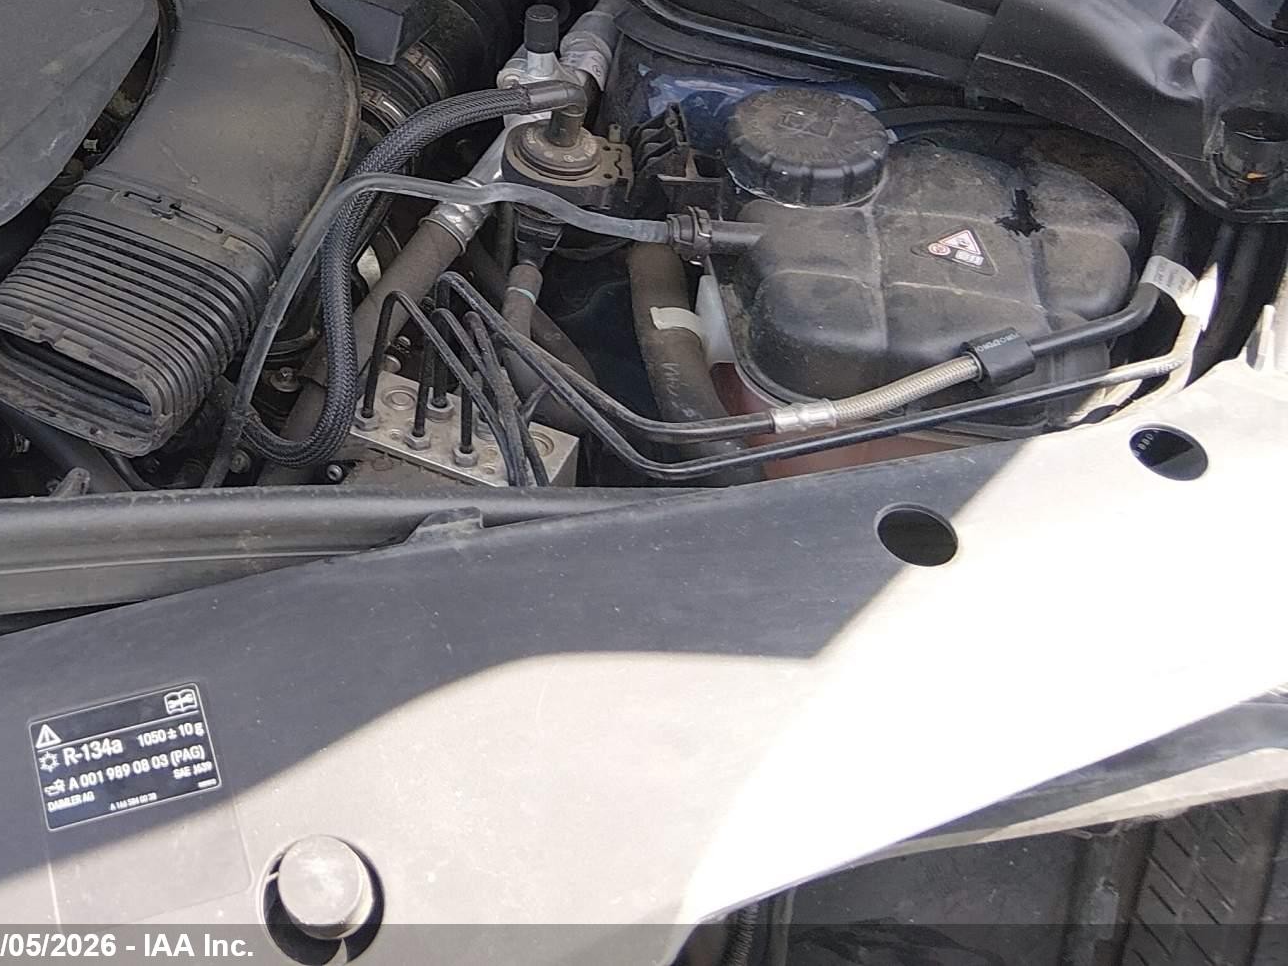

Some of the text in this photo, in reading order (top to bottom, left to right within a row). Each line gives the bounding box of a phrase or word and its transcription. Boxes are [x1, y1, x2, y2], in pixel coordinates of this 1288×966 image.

[137, 728, 166, 748] 1050
[177, 722, 195, 737] 10
[194, 722, 205, 737] g
[63, 738, 123, 766] R-134a
[69, 745, 205, 791] A 001 989 08 03 (PAG)
[173, 766, 192, 780] SAE
